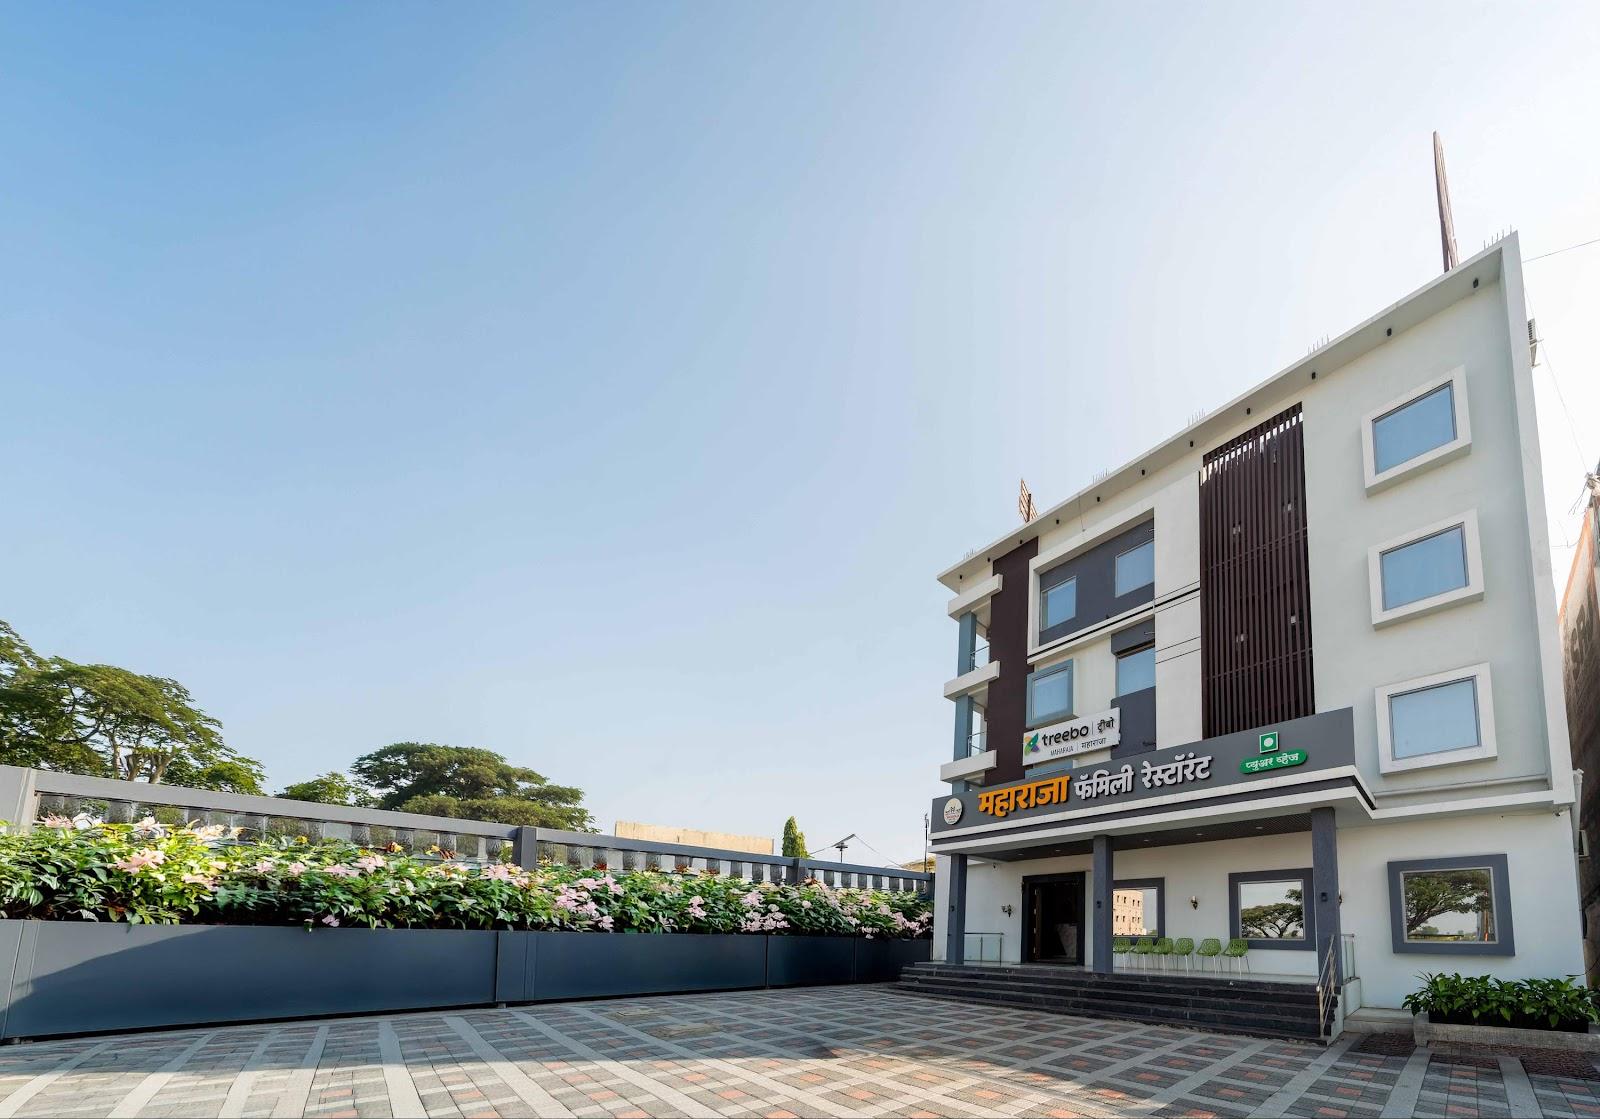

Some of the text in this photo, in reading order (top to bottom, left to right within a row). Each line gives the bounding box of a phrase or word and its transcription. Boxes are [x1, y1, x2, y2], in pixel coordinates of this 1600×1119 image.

[1097, 717, 1114, 732] ट्रीबो
[1041, 725, 1089, 746] treebo
[1081, 737, 1107, 749] महाराजा
[978, 752, 1212, 817] महाराजा फॅमिली रेस्टॉरंट
